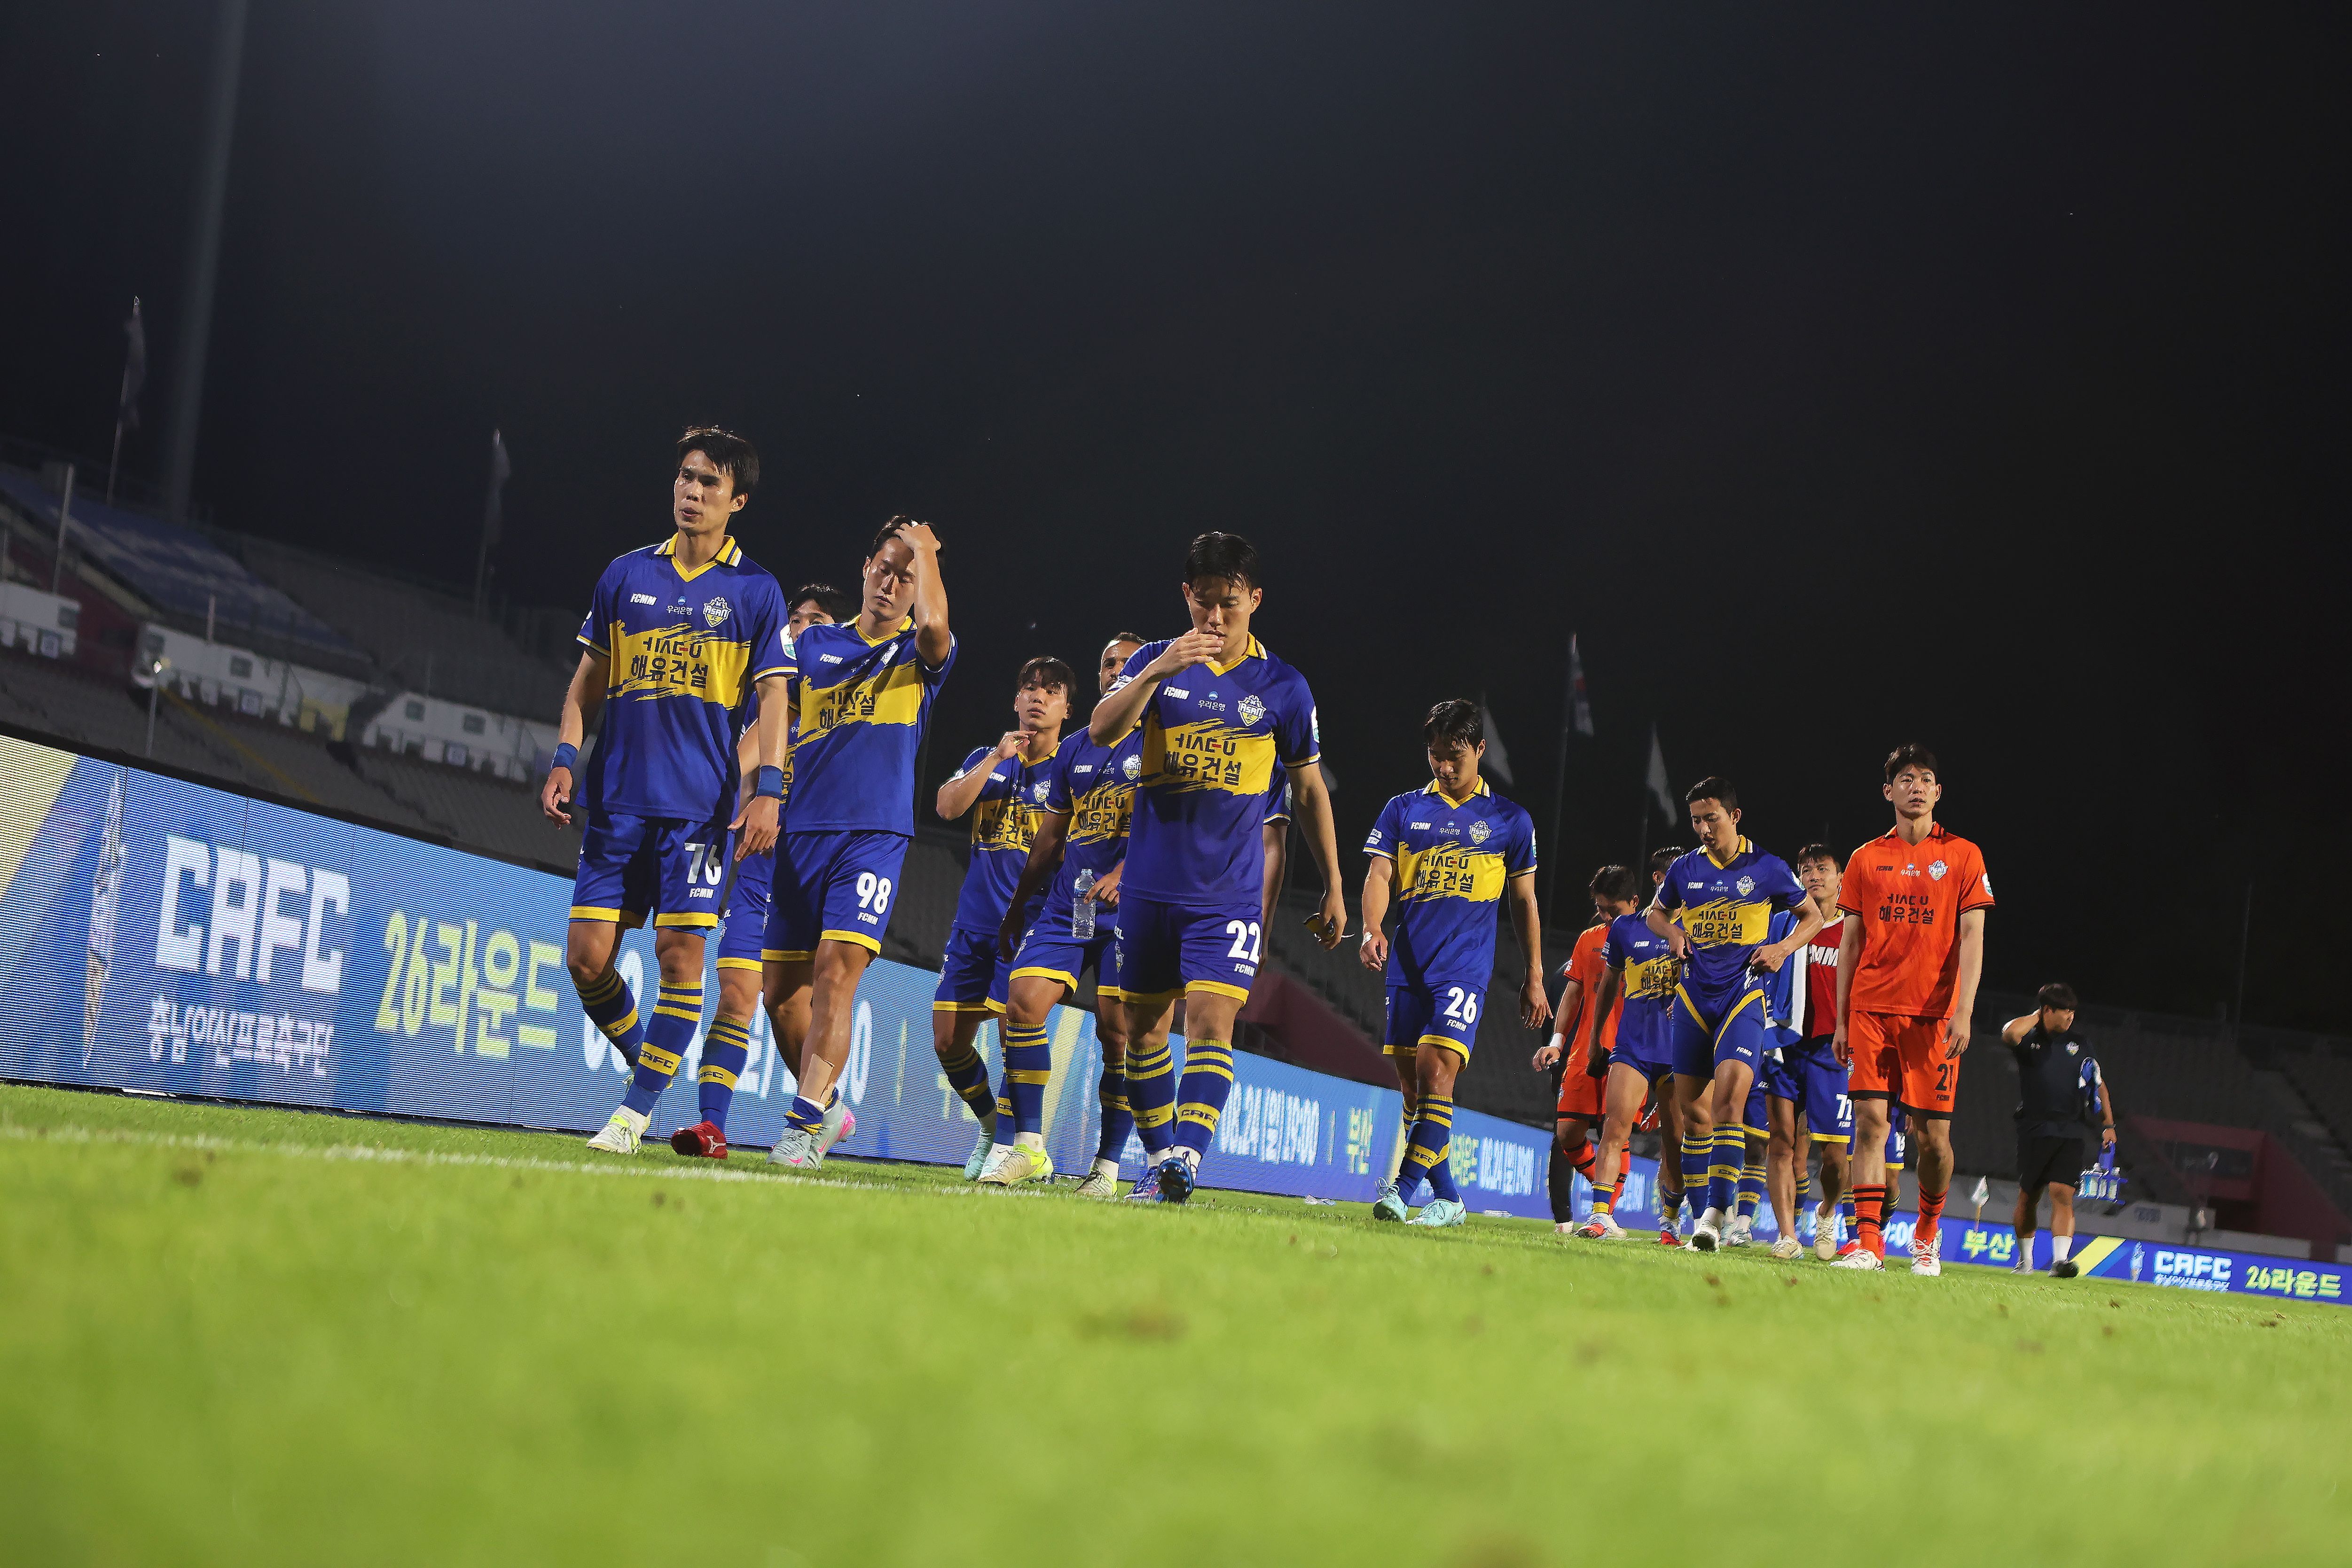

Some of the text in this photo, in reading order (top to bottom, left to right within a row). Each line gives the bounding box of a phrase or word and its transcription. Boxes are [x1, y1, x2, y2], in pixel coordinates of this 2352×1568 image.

[630, 593, 657, 606] FCMM
[666, 605, 693, 616] 우리은행
[819, 653, 844, 665] FCMM
[631, 654, 709, 689] 해유건설
[1163, 686, 1190, 700] FCMM
[1198, 700, 1226, 712] 우리은행
[989, 772, 1007, 783] CMM
[1410, 822, 1432, 831] FCMM
[1439, 827, 1461, 836] 우리은행
[684, 842, 722, 886] 76
[689, 888, 714, 899] FCMM
[856, 872, 892, 915] 98
[155, 832, 350, 993] CAFC
[857, 911, 878, 926] FCMM
[1879, 905, 1935, 925] 해유건설
[1226, 920, 1262, 965] 22
[1234, 963, 1255, 978] FCMM
[375, 910, 564, 1059] 26라운드
[1443, 986, 1478, 1026] 26
[1446, 1018, 1468, 1032] FCMM
[1962, 1229, 2016, 1261] 부산
[2154, 1250, 2233, 1281] CAFC
[2245, 1265, 2343, 1298] 26라운드
